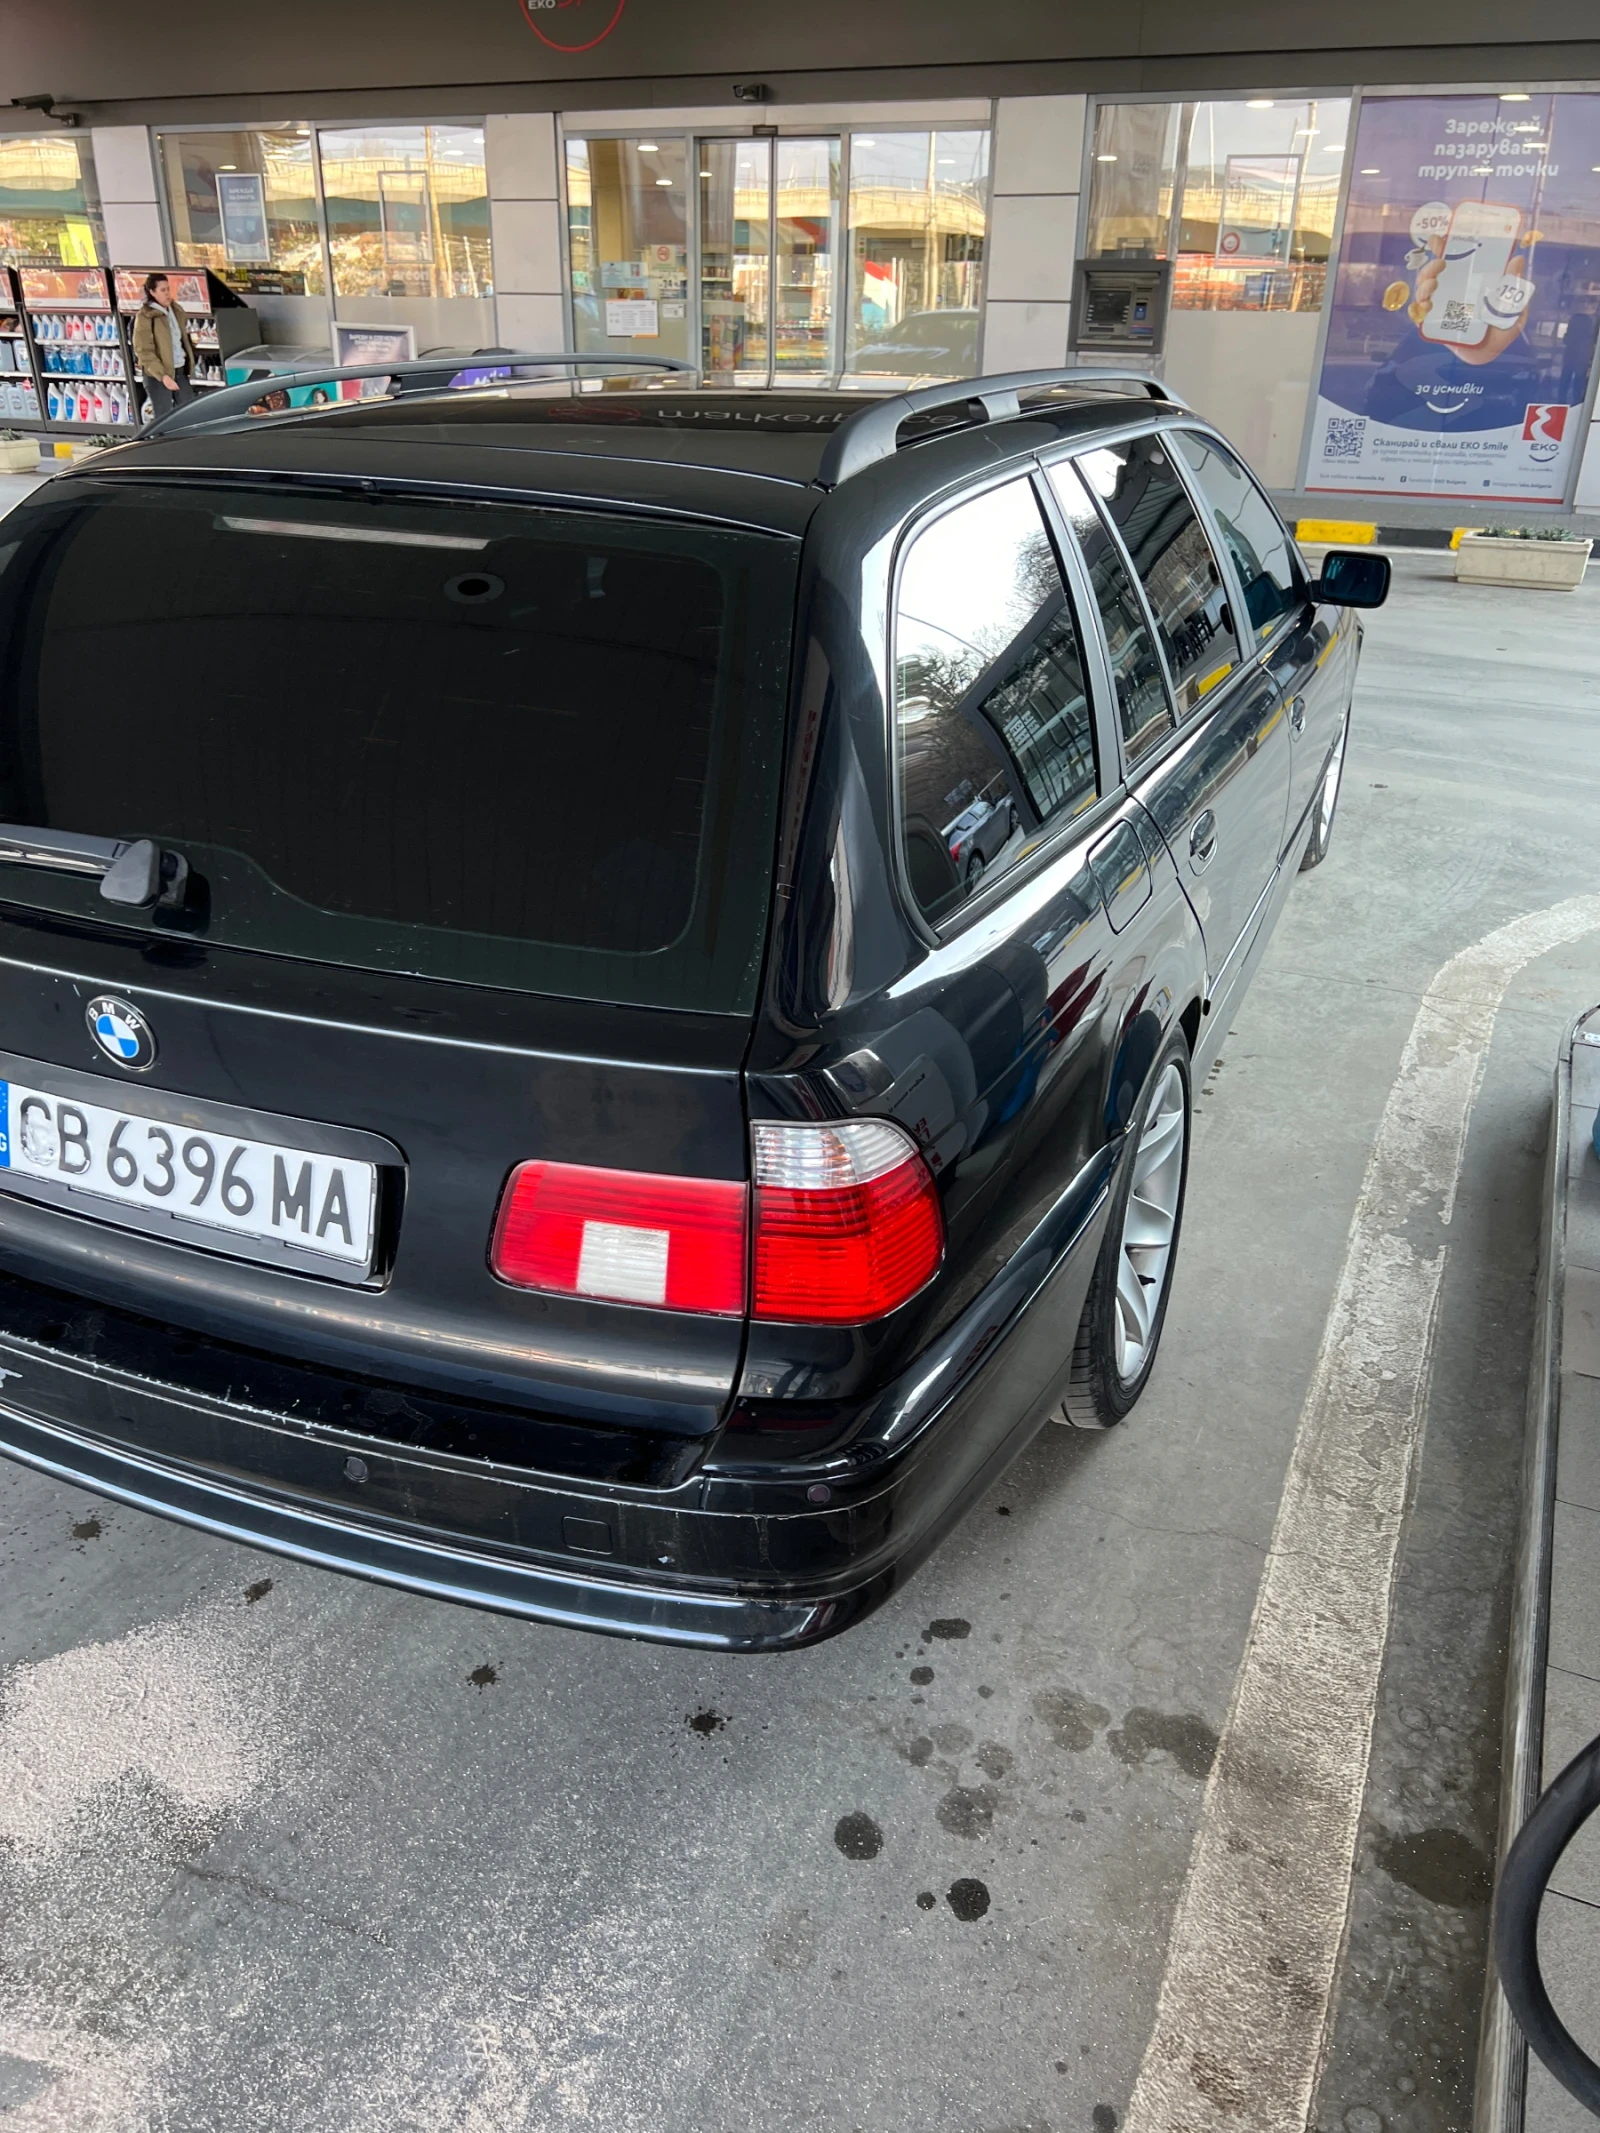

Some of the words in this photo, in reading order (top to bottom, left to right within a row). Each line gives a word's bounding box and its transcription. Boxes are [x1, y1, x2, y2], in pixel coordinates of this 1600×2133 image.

[527, 0, 556, 10] EKO
[1445, 115, 1545, 137] Зареждай,
[1418, 159, 1491, 181] трупай
[1495, 160, 1560, 177] точки
[1415, 384, 1431, 395] за
[1432, 382, 1484, 396] усмивки
[1372, 437, 1419, 450] Сканирай
[1429, 439, 1458, 450] свали
[1460, 441, 1480, 450] EKO
[1482, 441, 1509, 451] Smile
[1530, 443, 1559, 452] EKO
[88, 1001, 141, 1030] BMW
[106, 1119, 255, 1217] 6396
[271, 1152, 354, 1246] MA
